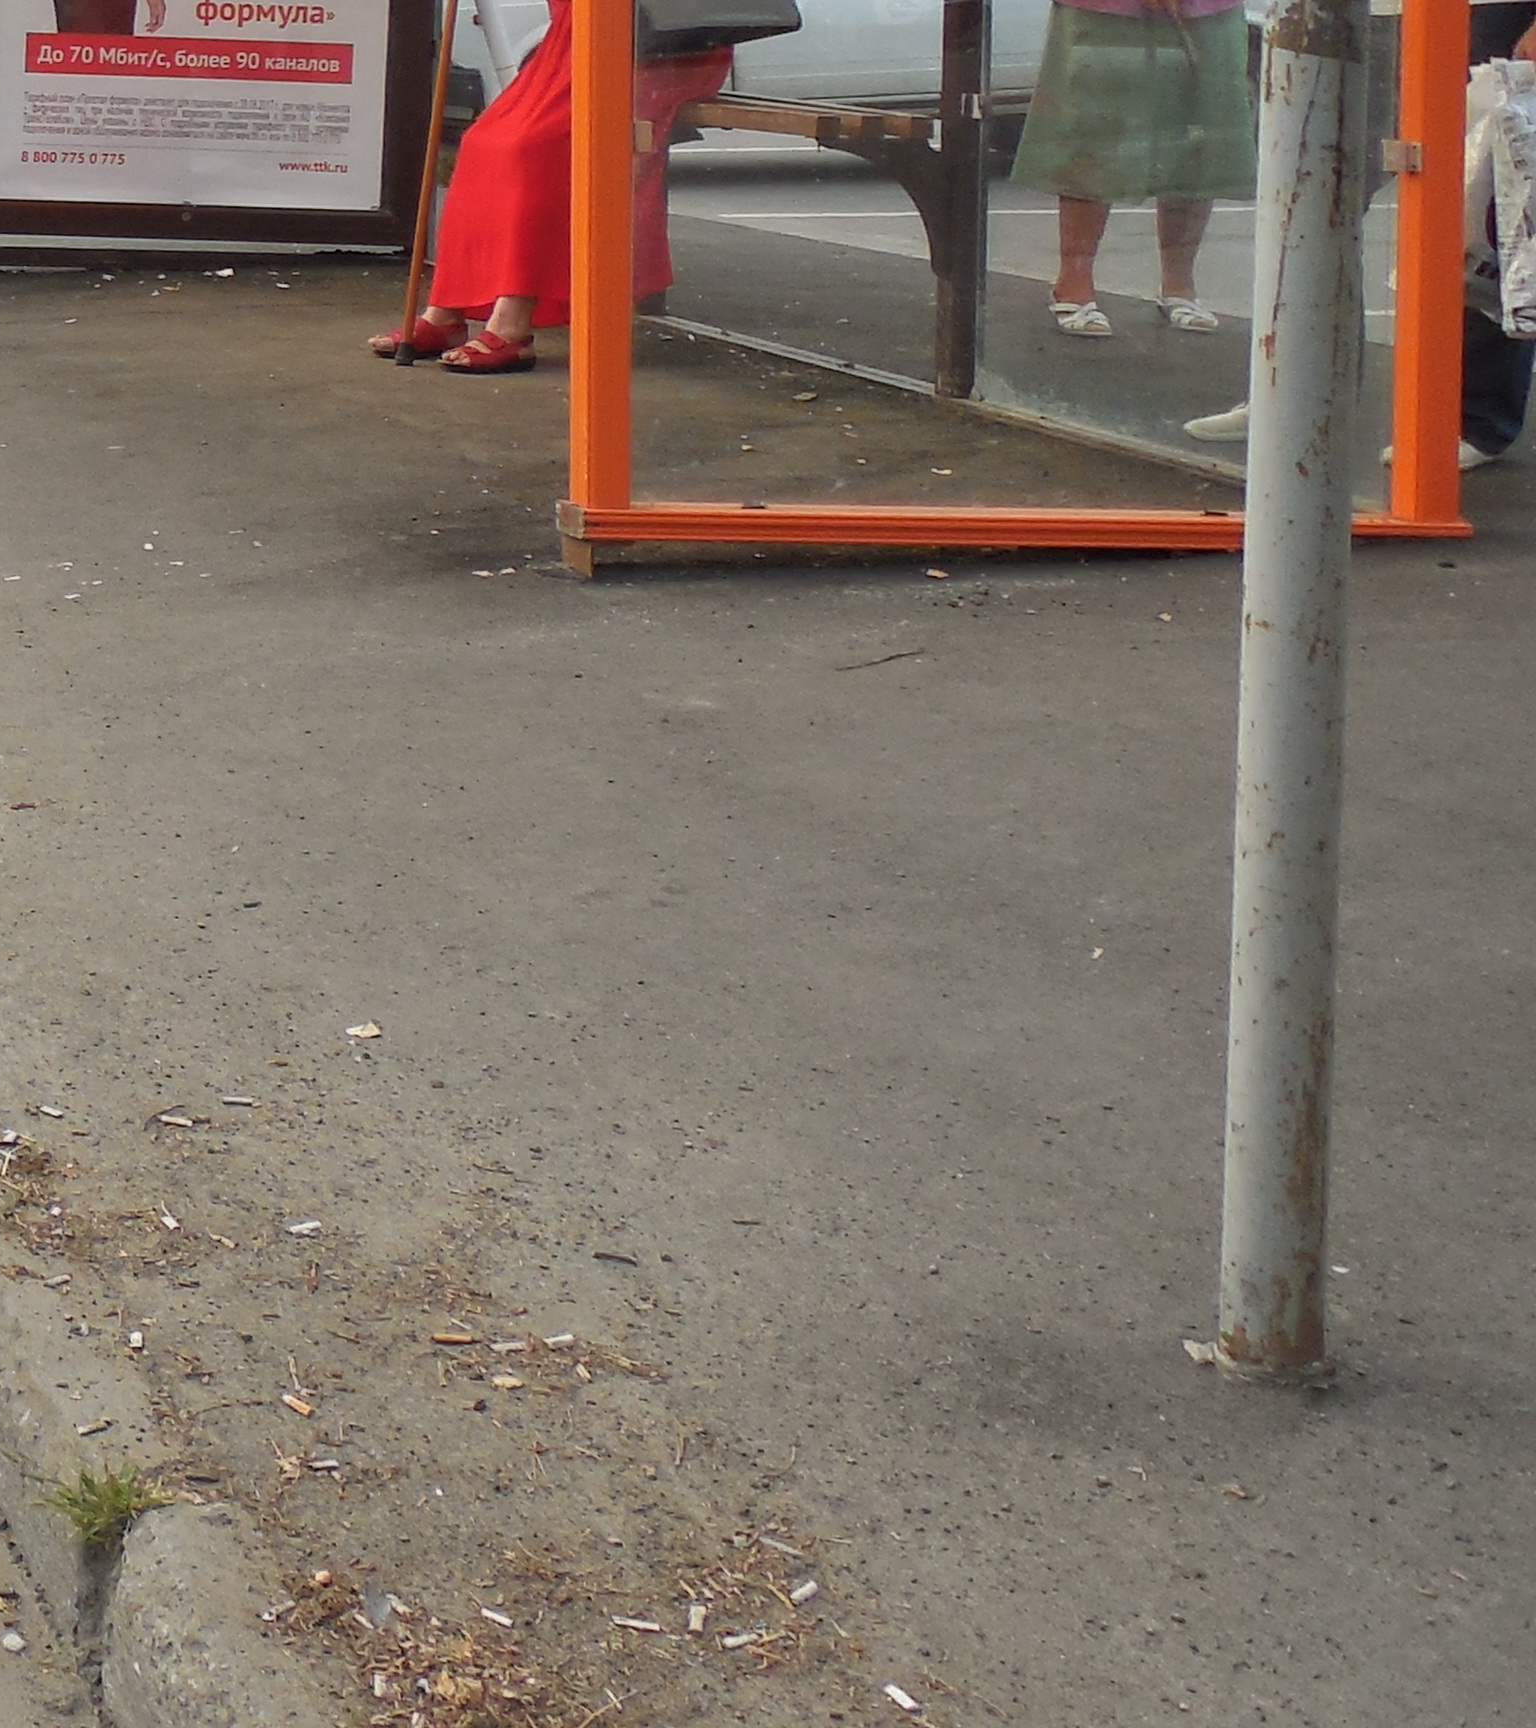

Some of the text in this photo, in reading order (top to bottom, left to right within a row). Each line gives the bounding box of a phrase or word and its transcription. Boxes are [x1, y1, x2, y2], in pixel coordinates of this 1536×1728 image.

[37, 45, 341, 73] До 70 Мбит/с, более 90 каналов
[21, 150, 126, 166] 8 800 775 0 775
[278, 161, 349, 174] www.ttk.ru
